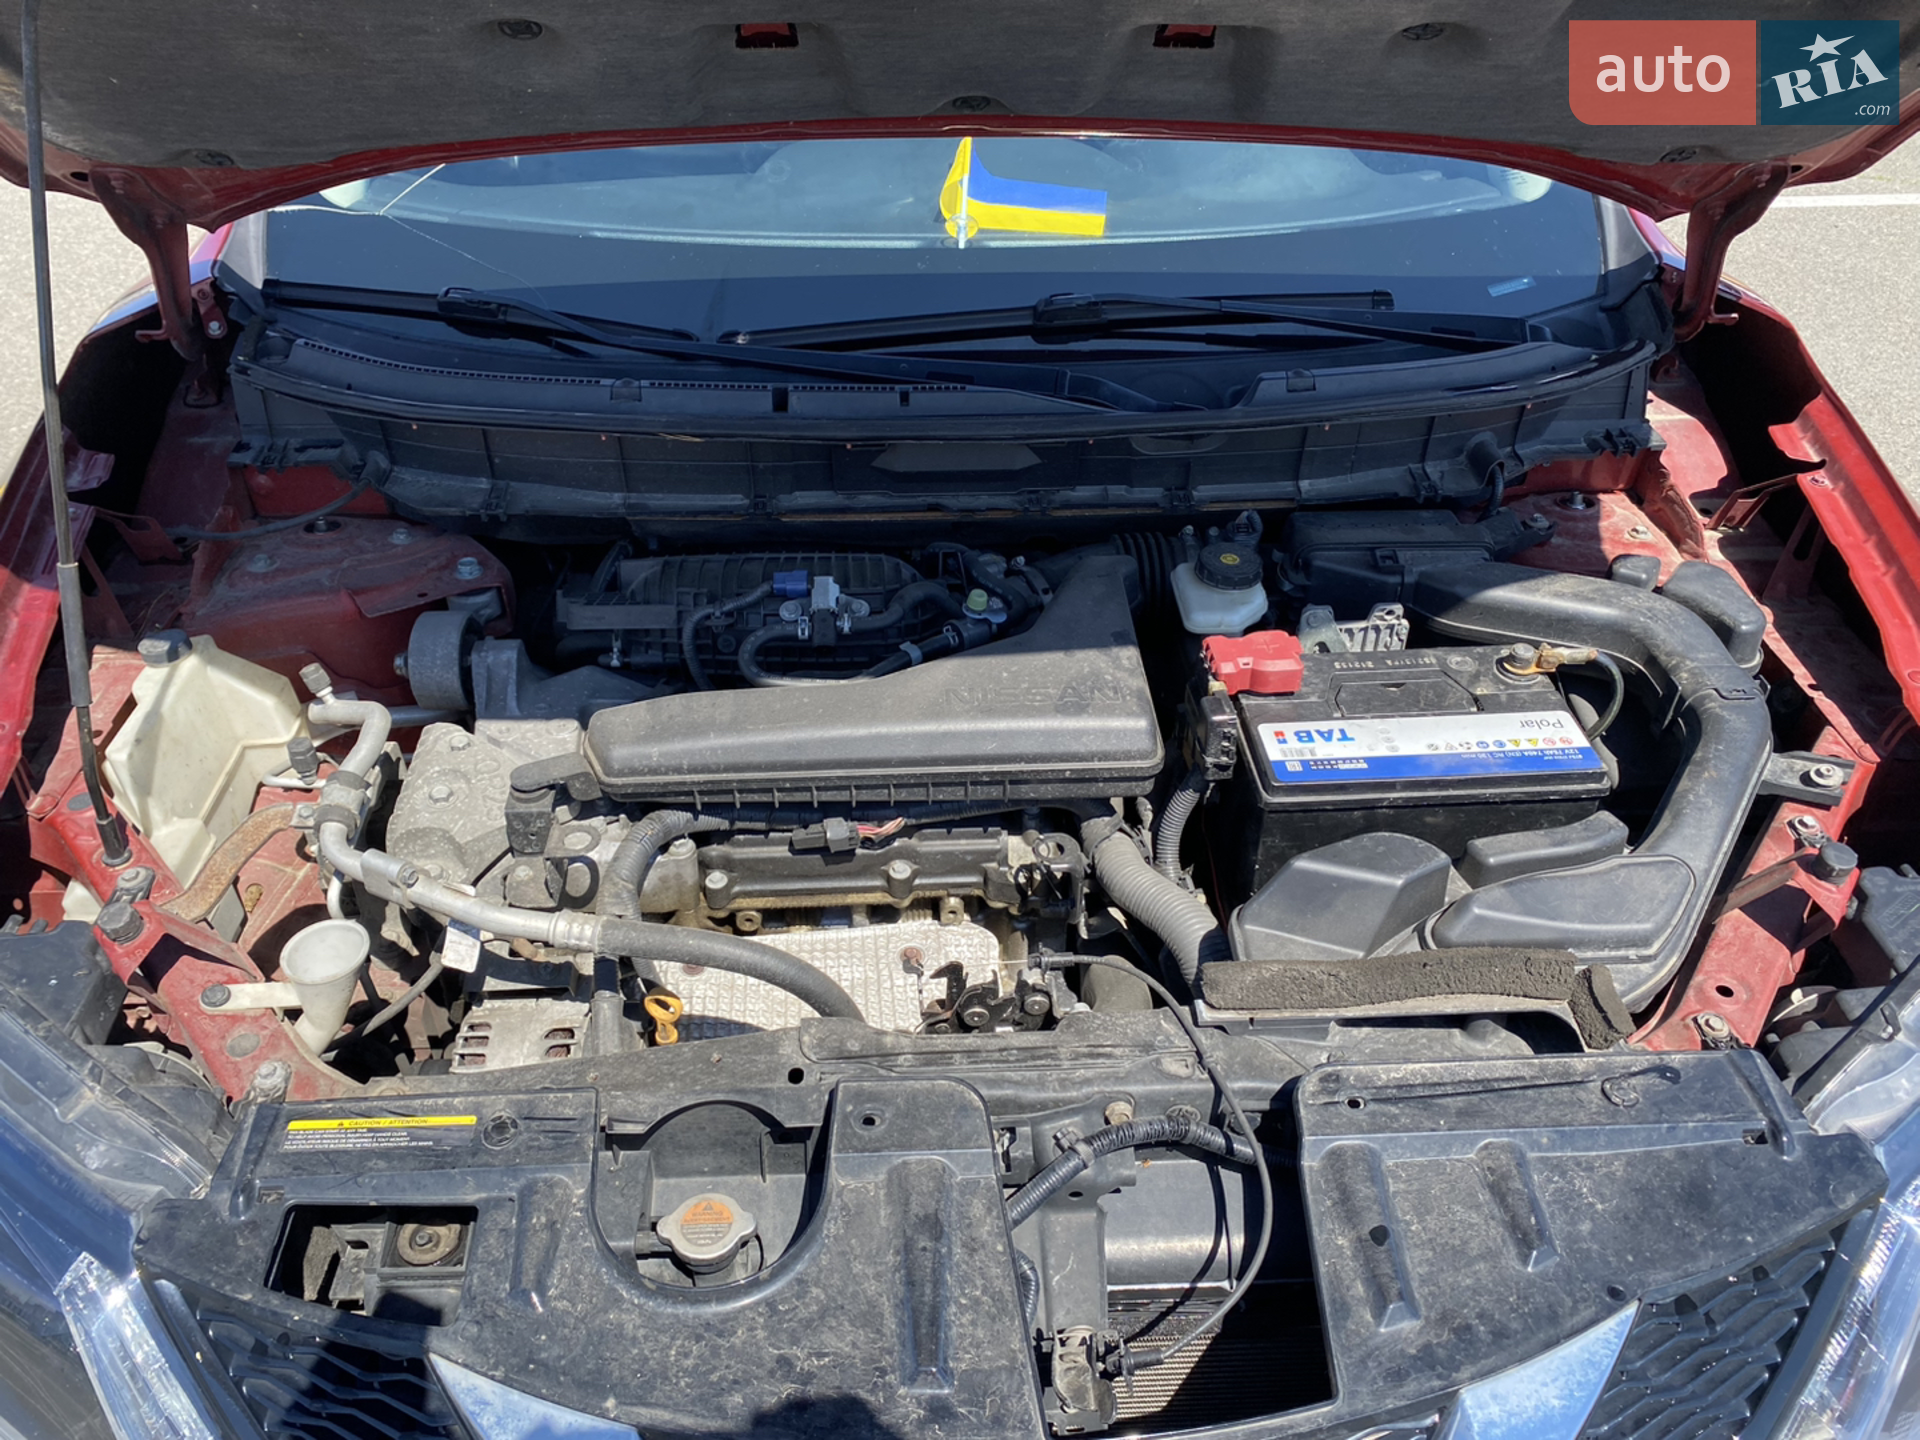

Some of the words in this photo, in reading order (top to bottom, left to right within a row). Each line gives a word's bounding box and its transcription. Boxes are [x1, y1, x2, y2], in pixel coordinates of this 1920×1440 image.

[944, 685, 1121, 706] NISSAN
[1519, 719, 1564, 730] Polar
[1293, 728, 1355, 744] TAB
